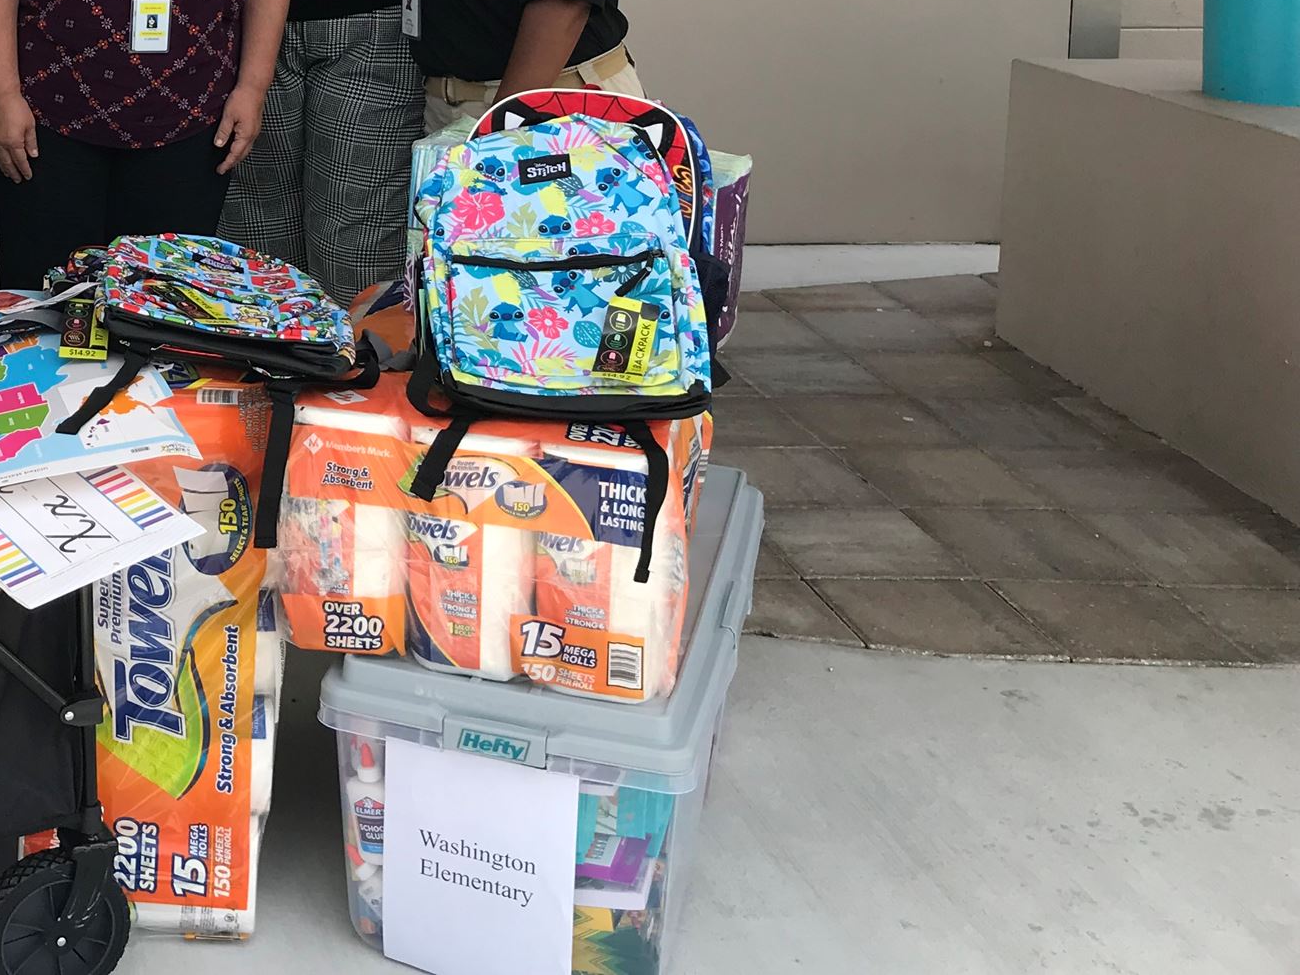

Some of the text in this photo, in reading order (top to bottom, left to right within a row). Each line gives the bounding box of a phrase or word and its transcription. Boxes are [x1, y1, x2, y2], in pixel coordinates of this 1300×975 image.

[68, 349, 96, 357] $14.92
[632, 323, 652, 371] BACKPACK
[326, 440, 366, 454] Member's
[322, 474, 373, 490] Absorbent
[326, 461, 369, 477] Strong &
[599, 481, 647, 503] THICK
[220, 499, 238, 534] 150
[514, 503, 530, 512] 150
[600, 501, 645, 519] & LONG
[600, 515, 644, 532] LASTING
[230, 534, 247, 563] SELECT
[98, 579, 109, 629] Super
[111, 569, 122, 645] Premium
[324, 601, 361, 616] OVER
[325, 615, 382, 636] 2200
[522, 621, 563, 657] 15
[113, 547, 184, 741] Towel
[326, 636, 381, 649] SHEETS
[564, 646, 596, 659] MEGA
[521, 663, 596, 683] 150 SHEETS
[562, 654, 596, 667] ROLLS
[576, 679, 594, 691] ROLL
[216, 625, 240, 793] Strong & Absorbent
[460, 733, 526, 760] Hefty
[190, 825, 199, 856] MEGA
[199, 825, 208, 858] ROLLS
[224, 827, 232, 846] ROLL
[113, 819, 138, 891] 2200
[139, 825, 158, 891] SHEETS
[214, 826, 231, 897] 150 SHEETS
[419, 829, 537, 875] Washington
[173, 855, 206, 896] 15
[419, 859, 534, 907] Elementary
